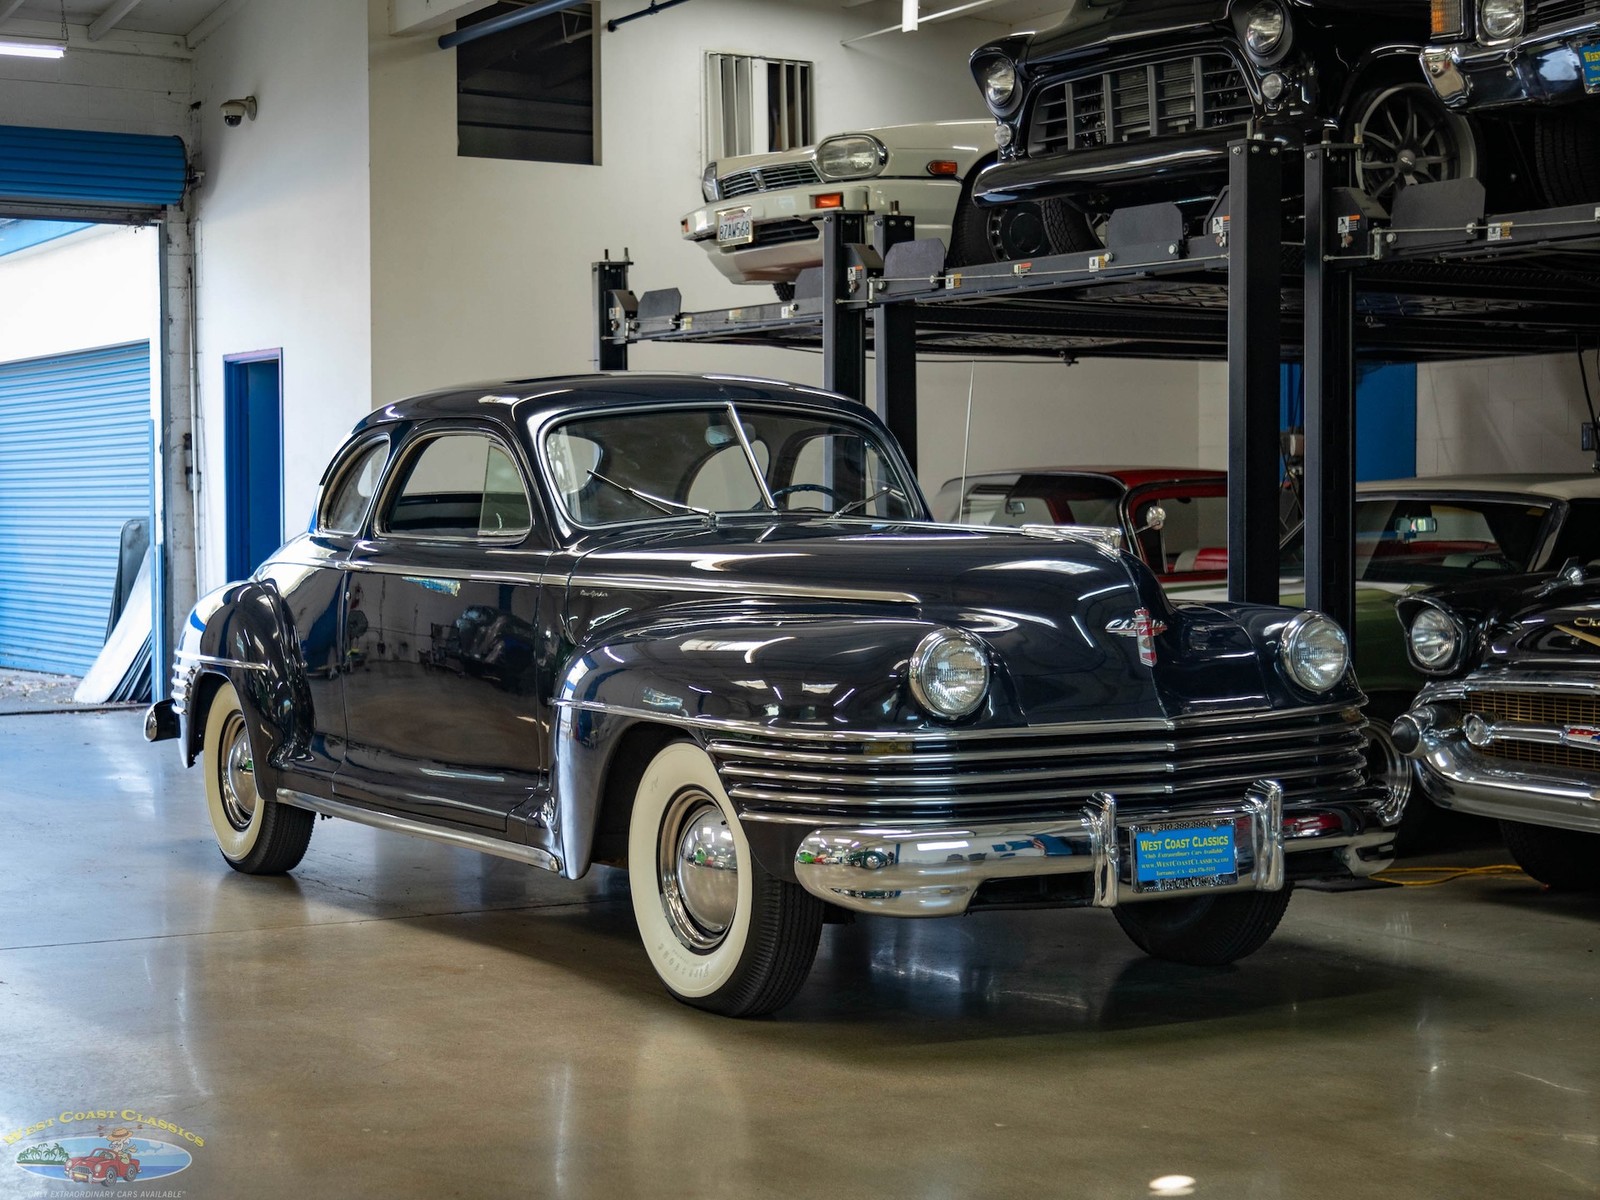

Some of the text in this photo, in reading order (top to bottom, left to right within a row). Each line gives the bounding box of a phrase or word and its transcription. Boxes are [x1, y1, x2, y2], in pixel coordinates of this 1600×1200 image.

[1140, 835, 1229, 852] WEST COAST CLASSICS
